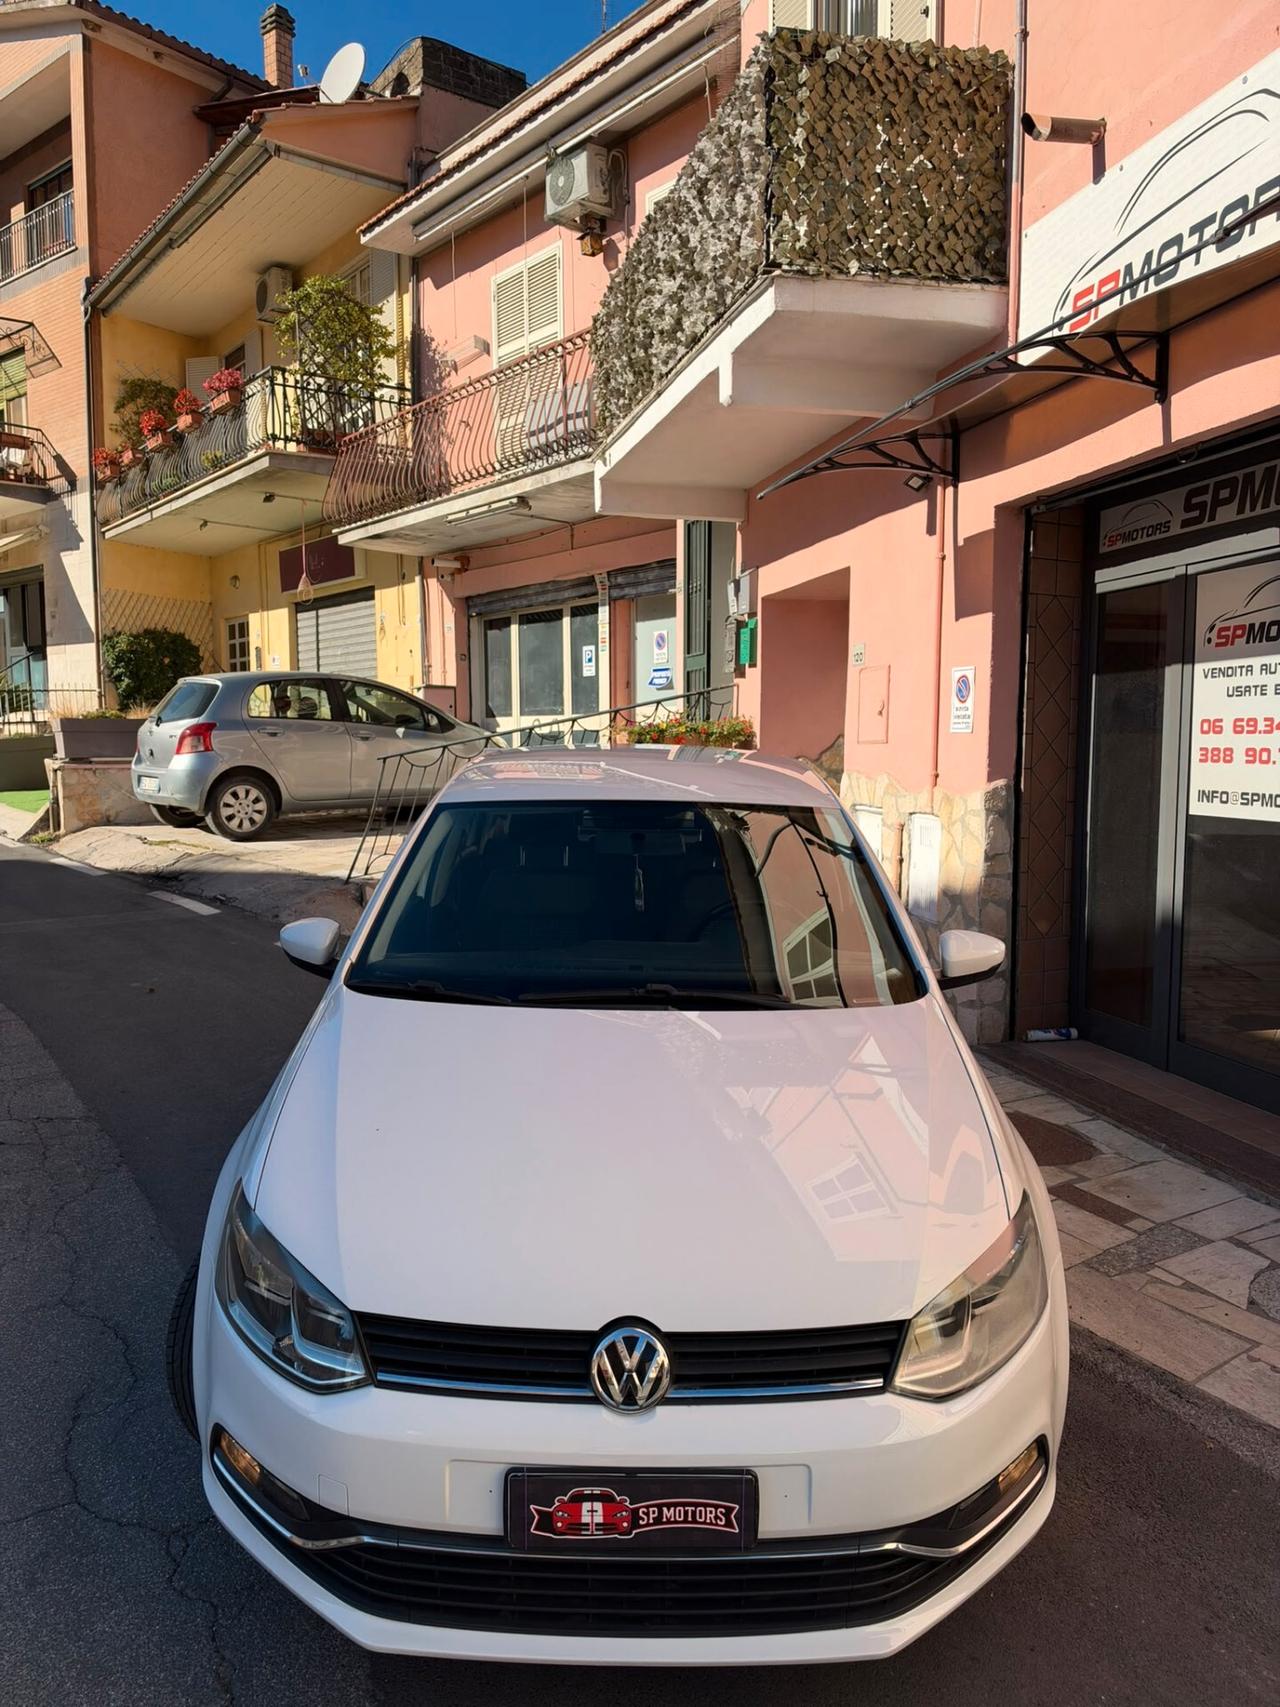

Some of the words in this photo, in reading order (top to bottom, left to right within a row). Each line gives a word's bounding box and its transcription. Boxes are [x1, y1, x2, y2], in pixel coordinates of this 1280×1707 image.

[1180, 463, 1280, 529] SPM
[1107, 520, 1171, 547] SPMOTORS
[1202, 664, 1253, 679] VENDITA
[1260, 662, 1280, 675] AU
[1226, 684, 1268, 697] USATE
[1200, 718, 1223, 735] 06
[1199, 747, 1234, 764] 388
[638, 1508, 659, 1524] SP
[662, 1506, 726, 1525] MOTORS
